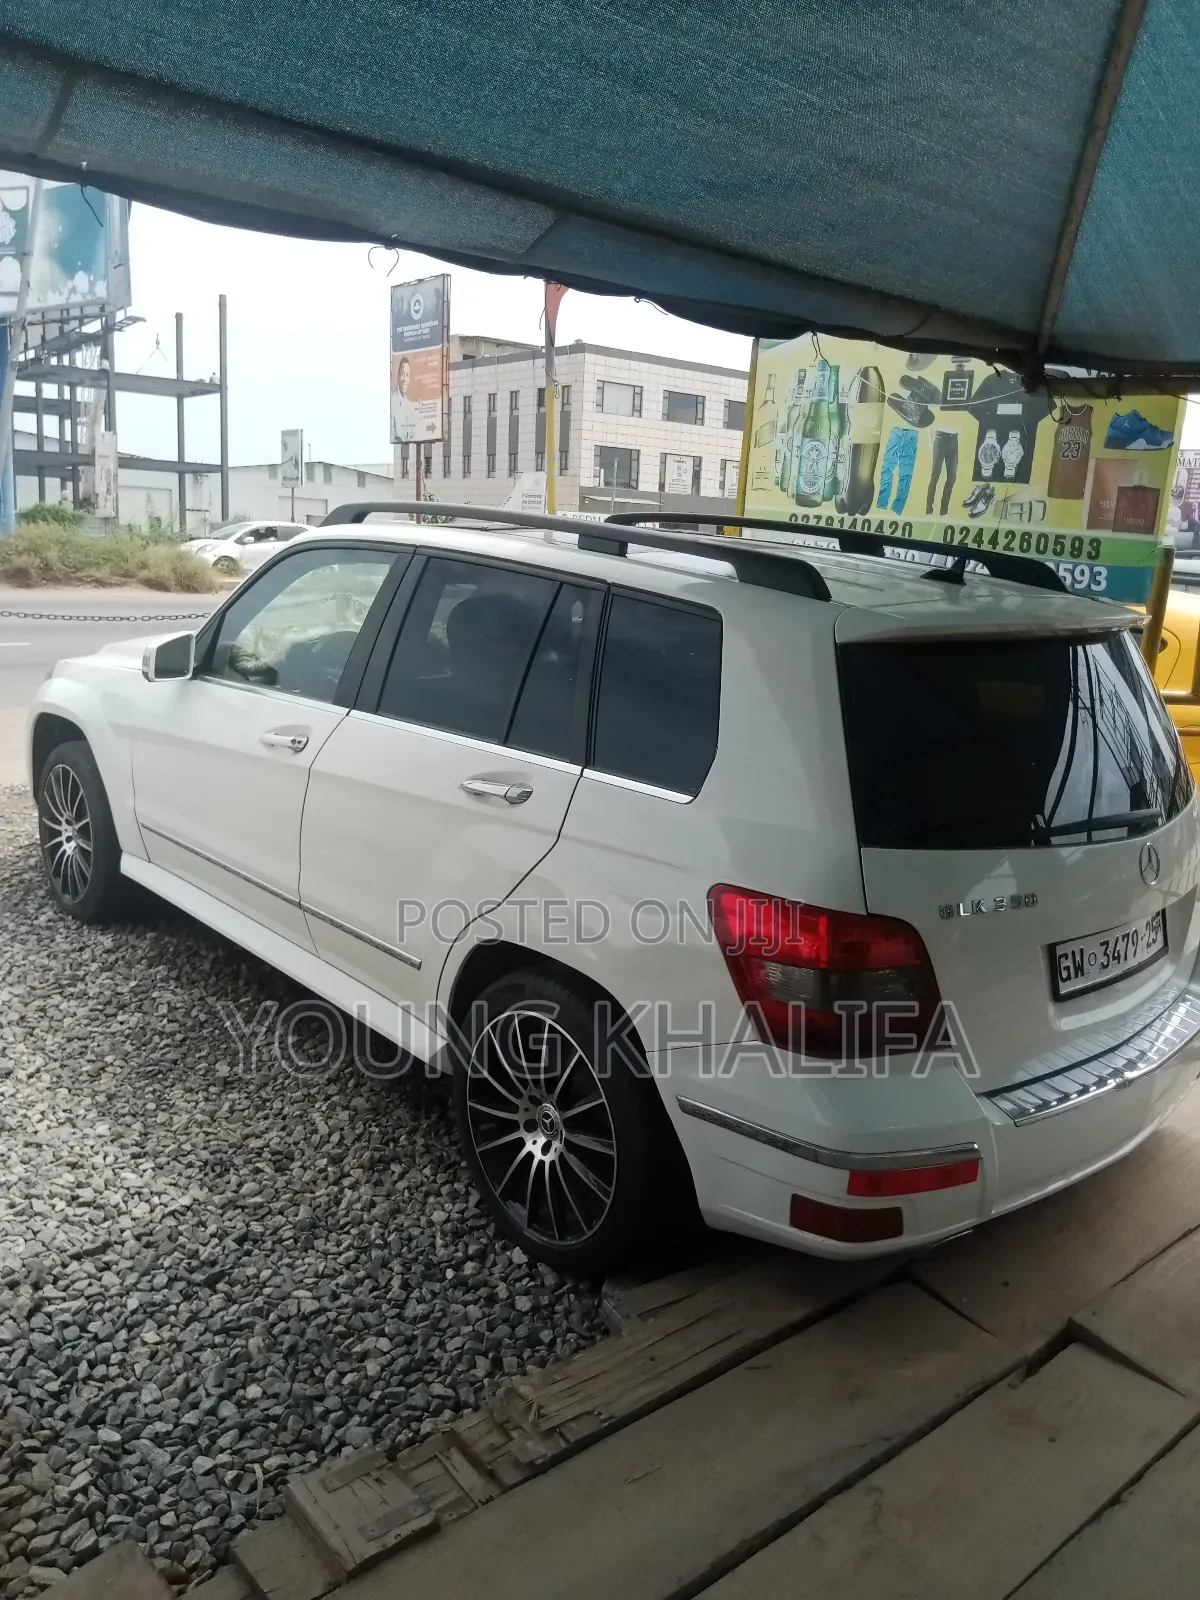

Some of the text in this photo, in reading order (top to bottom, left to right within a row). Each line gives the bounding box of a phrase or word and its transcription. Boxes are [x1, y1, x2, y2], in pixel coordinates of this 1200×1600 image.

[1060, 440, 1081, 460] 23
[943, 525, 1102, 561] 0244260593
[1045, 561, 1108, 592] 593
[1057, 945, 1085, 983] GW
